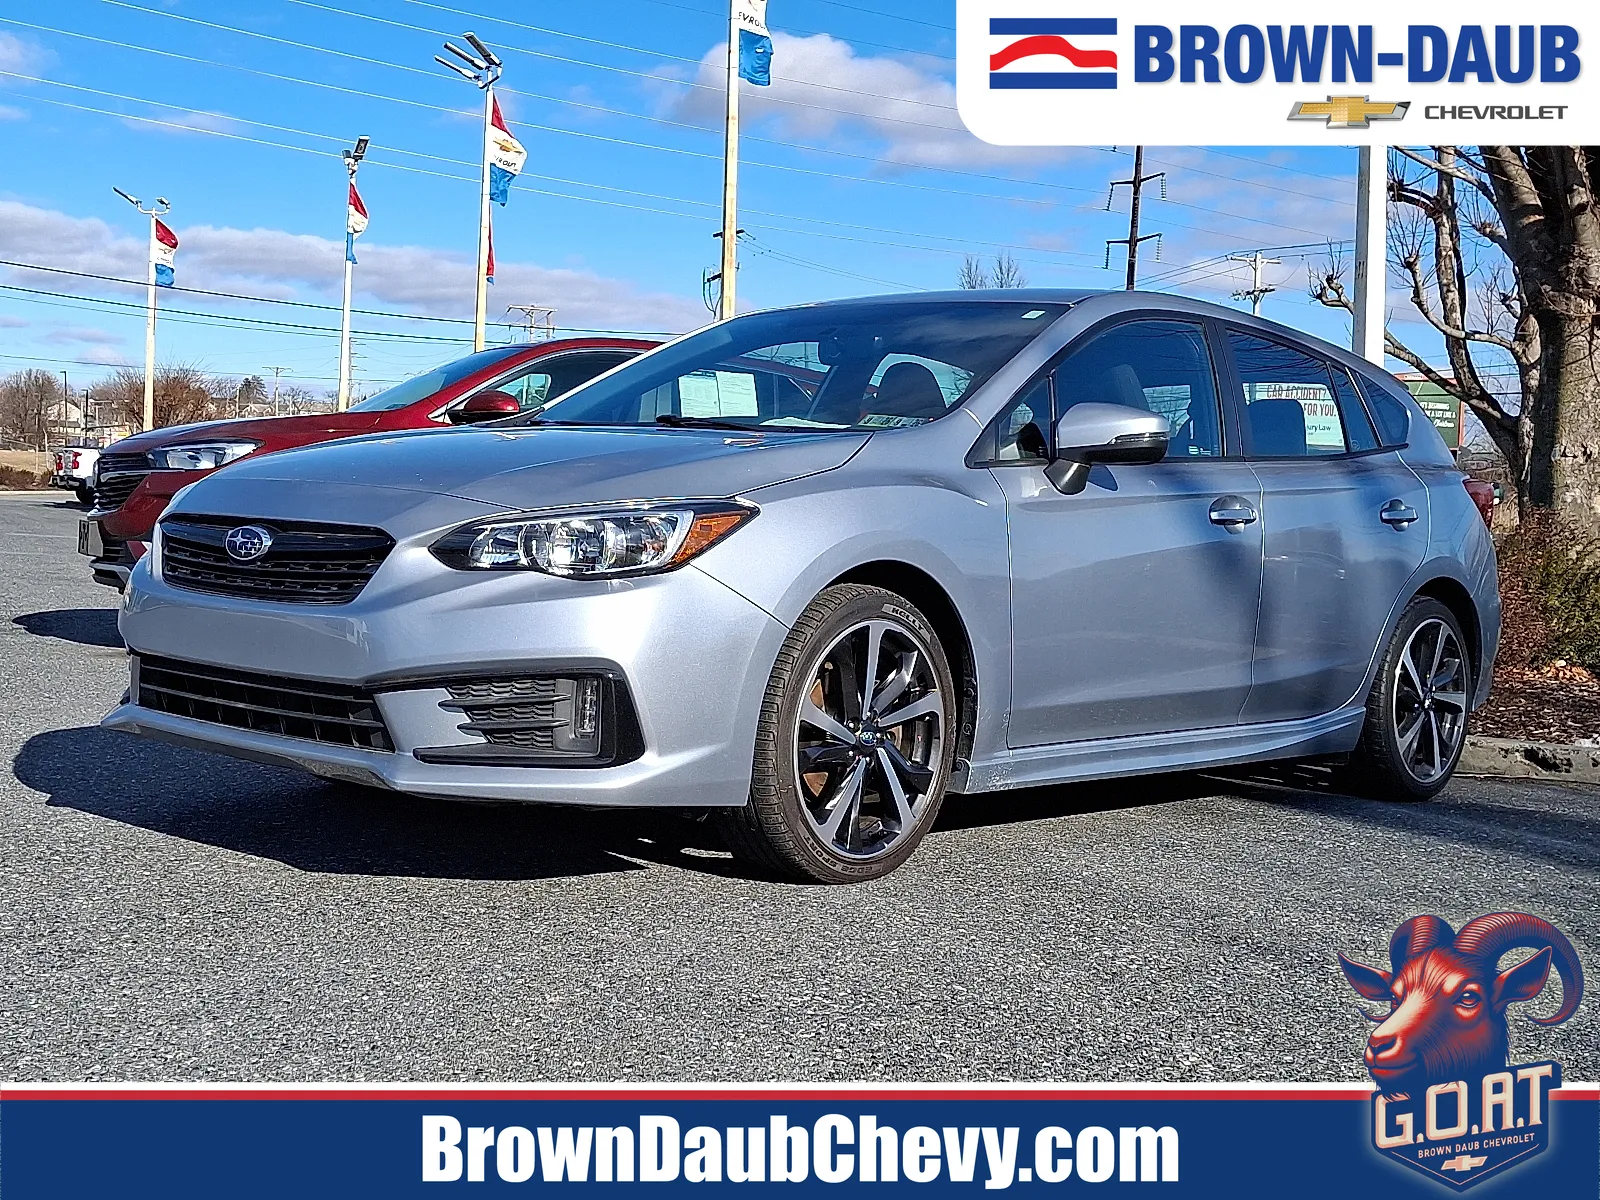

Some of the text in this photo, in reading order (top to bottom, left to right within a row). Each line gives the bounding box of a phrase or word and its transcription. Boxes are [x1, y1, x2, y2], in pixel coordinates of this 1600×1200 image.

[1267, 384, 1284, 399] CAR
[1304, 402, 1337, 418] FOR YOU.
[891, 607, 924, 631] KELLY
[803, 834, 838, 868] SPORT
